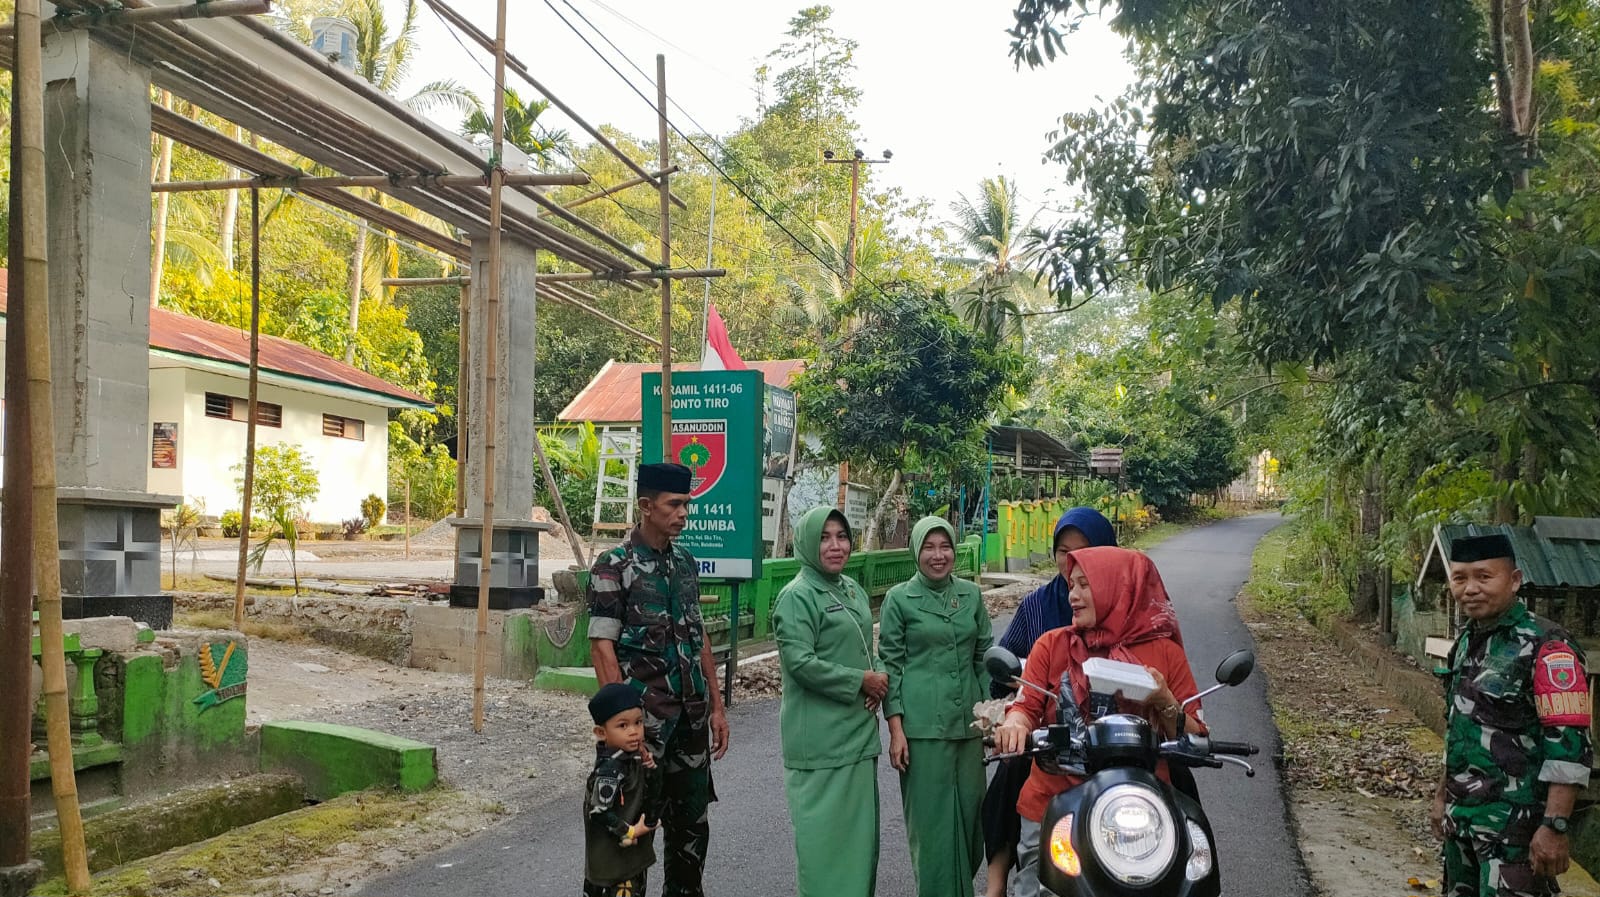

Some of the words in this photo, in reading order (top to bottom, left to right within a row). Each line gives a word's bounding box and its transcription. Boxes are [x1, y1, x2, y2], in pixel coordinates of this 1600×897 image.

[703, 383, 743, 394] 1411-06
[704, 398, 729, 408] TIRO
[671, 423, 724, 433] ASANUDDIN
[703, 503, 732, 515] 1411
